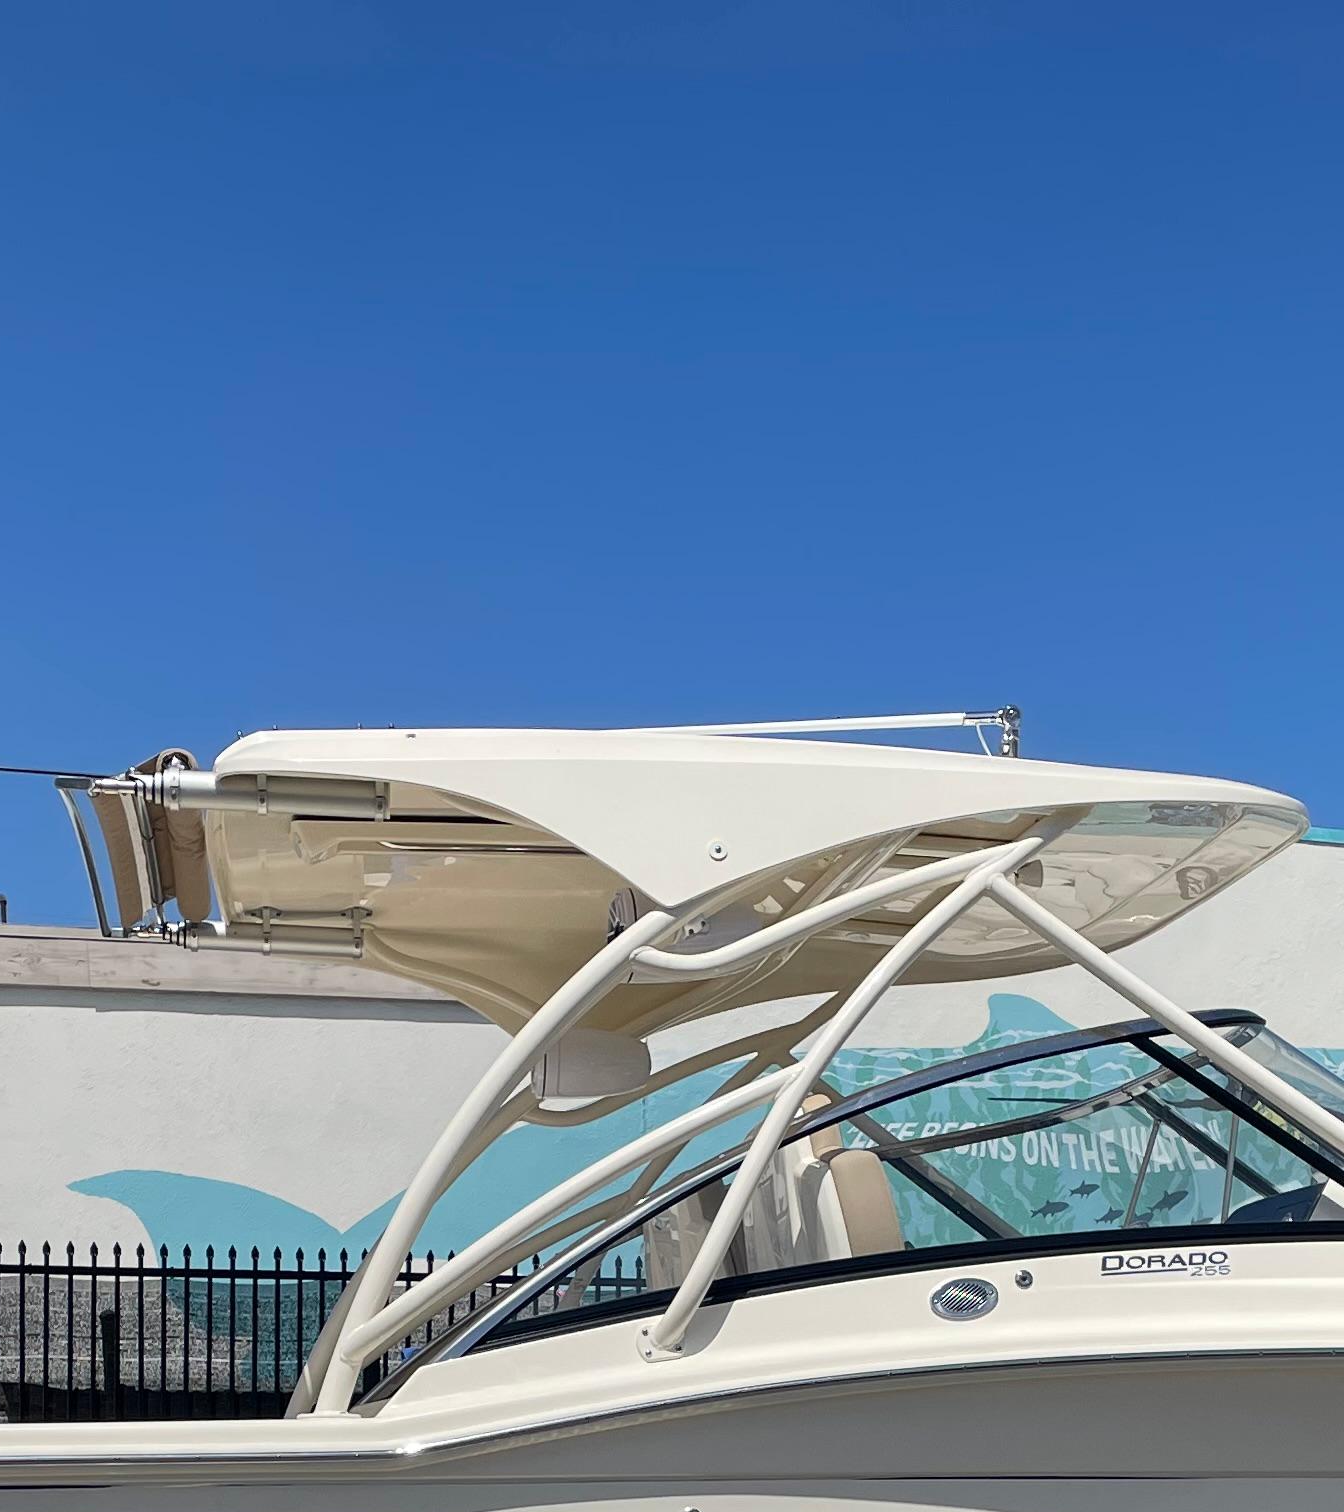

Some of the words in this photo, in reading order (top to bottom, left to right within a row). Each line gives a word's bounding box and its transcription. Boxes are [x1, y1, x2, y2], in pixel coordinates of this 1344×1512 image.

[1022, 1131, 1060, 1168] ON
[1062, 1131, 1121, 1173] THE
[1101, 1251, 1229, 1272] DORADO
[1190, 1264, 1232, 1277] 255
